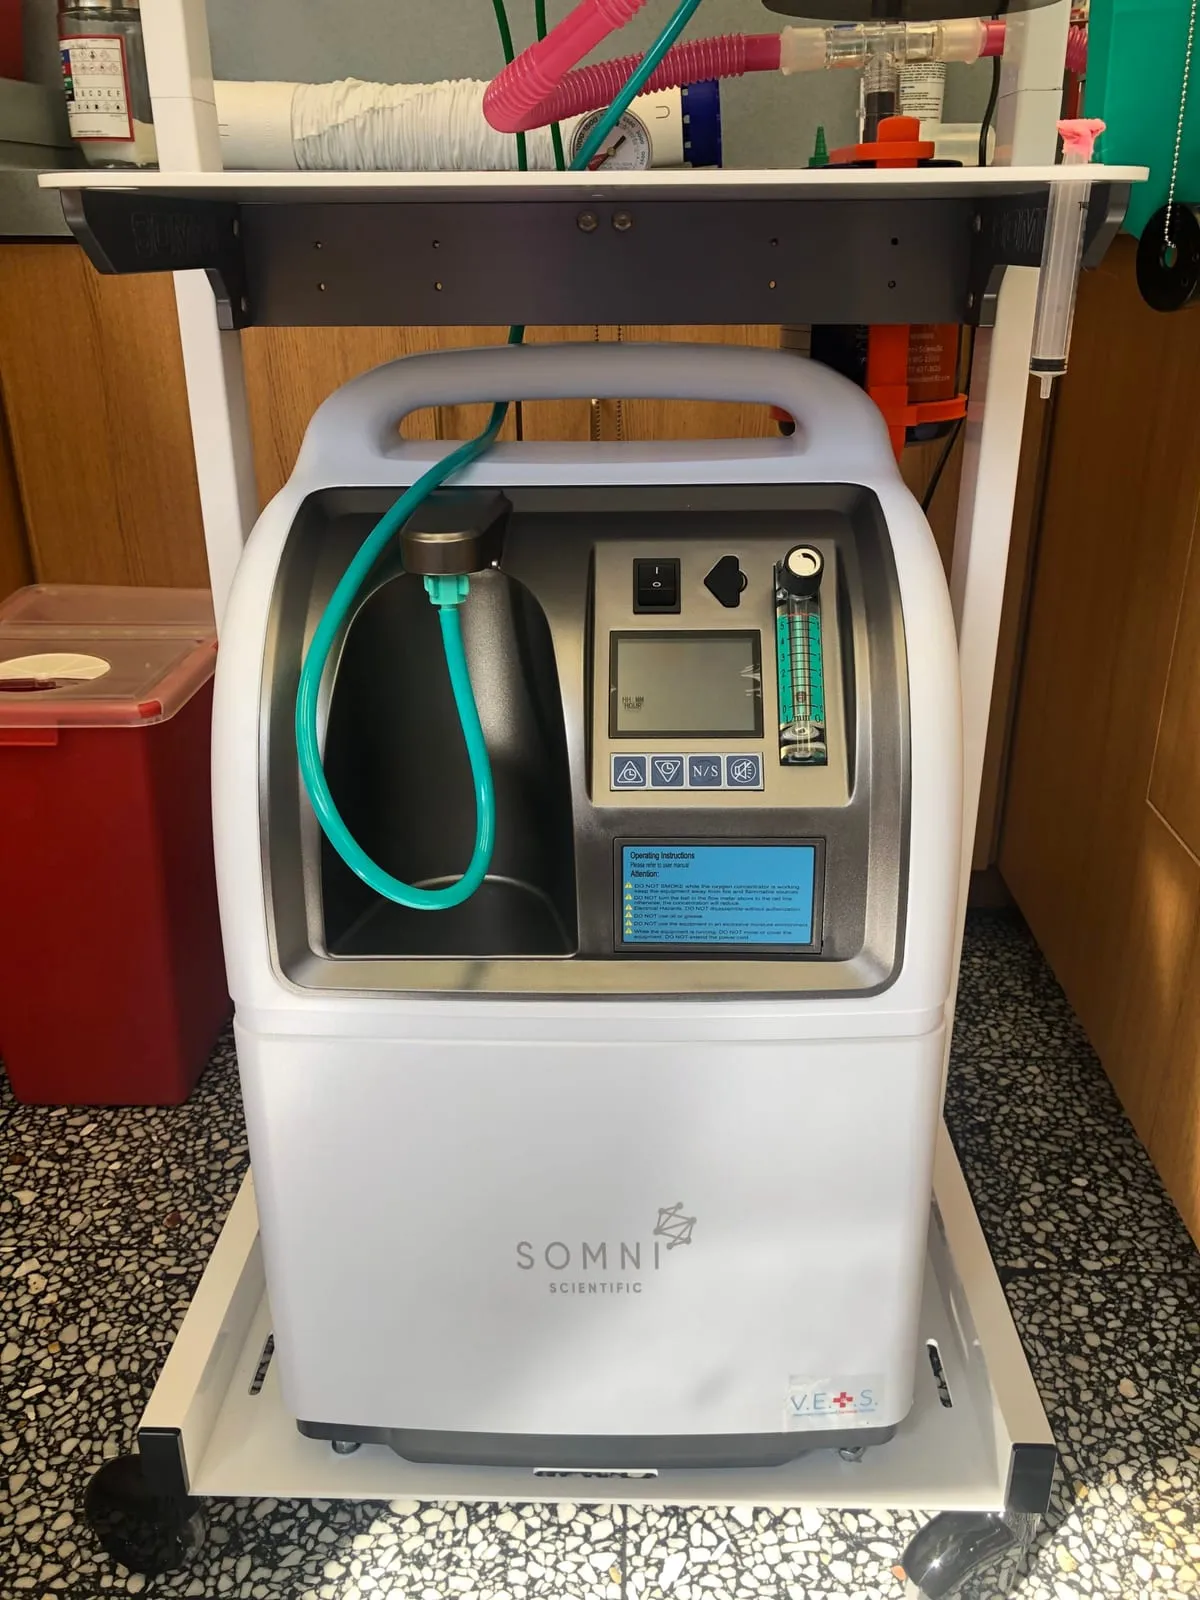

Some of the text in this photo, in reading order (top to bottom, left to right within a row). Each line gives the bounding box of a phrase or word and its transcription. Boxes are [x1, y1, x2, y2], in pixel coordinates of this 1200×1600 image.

[692, 764, 719, 778] N/S
[630, 852, 695, 860] Operating Instructions
[630, 870, 660, 878] Attention:
[516, 1241, 659, 1270] SOMNI
[550, 1282, 642, 1294] SCIENTIFIC
